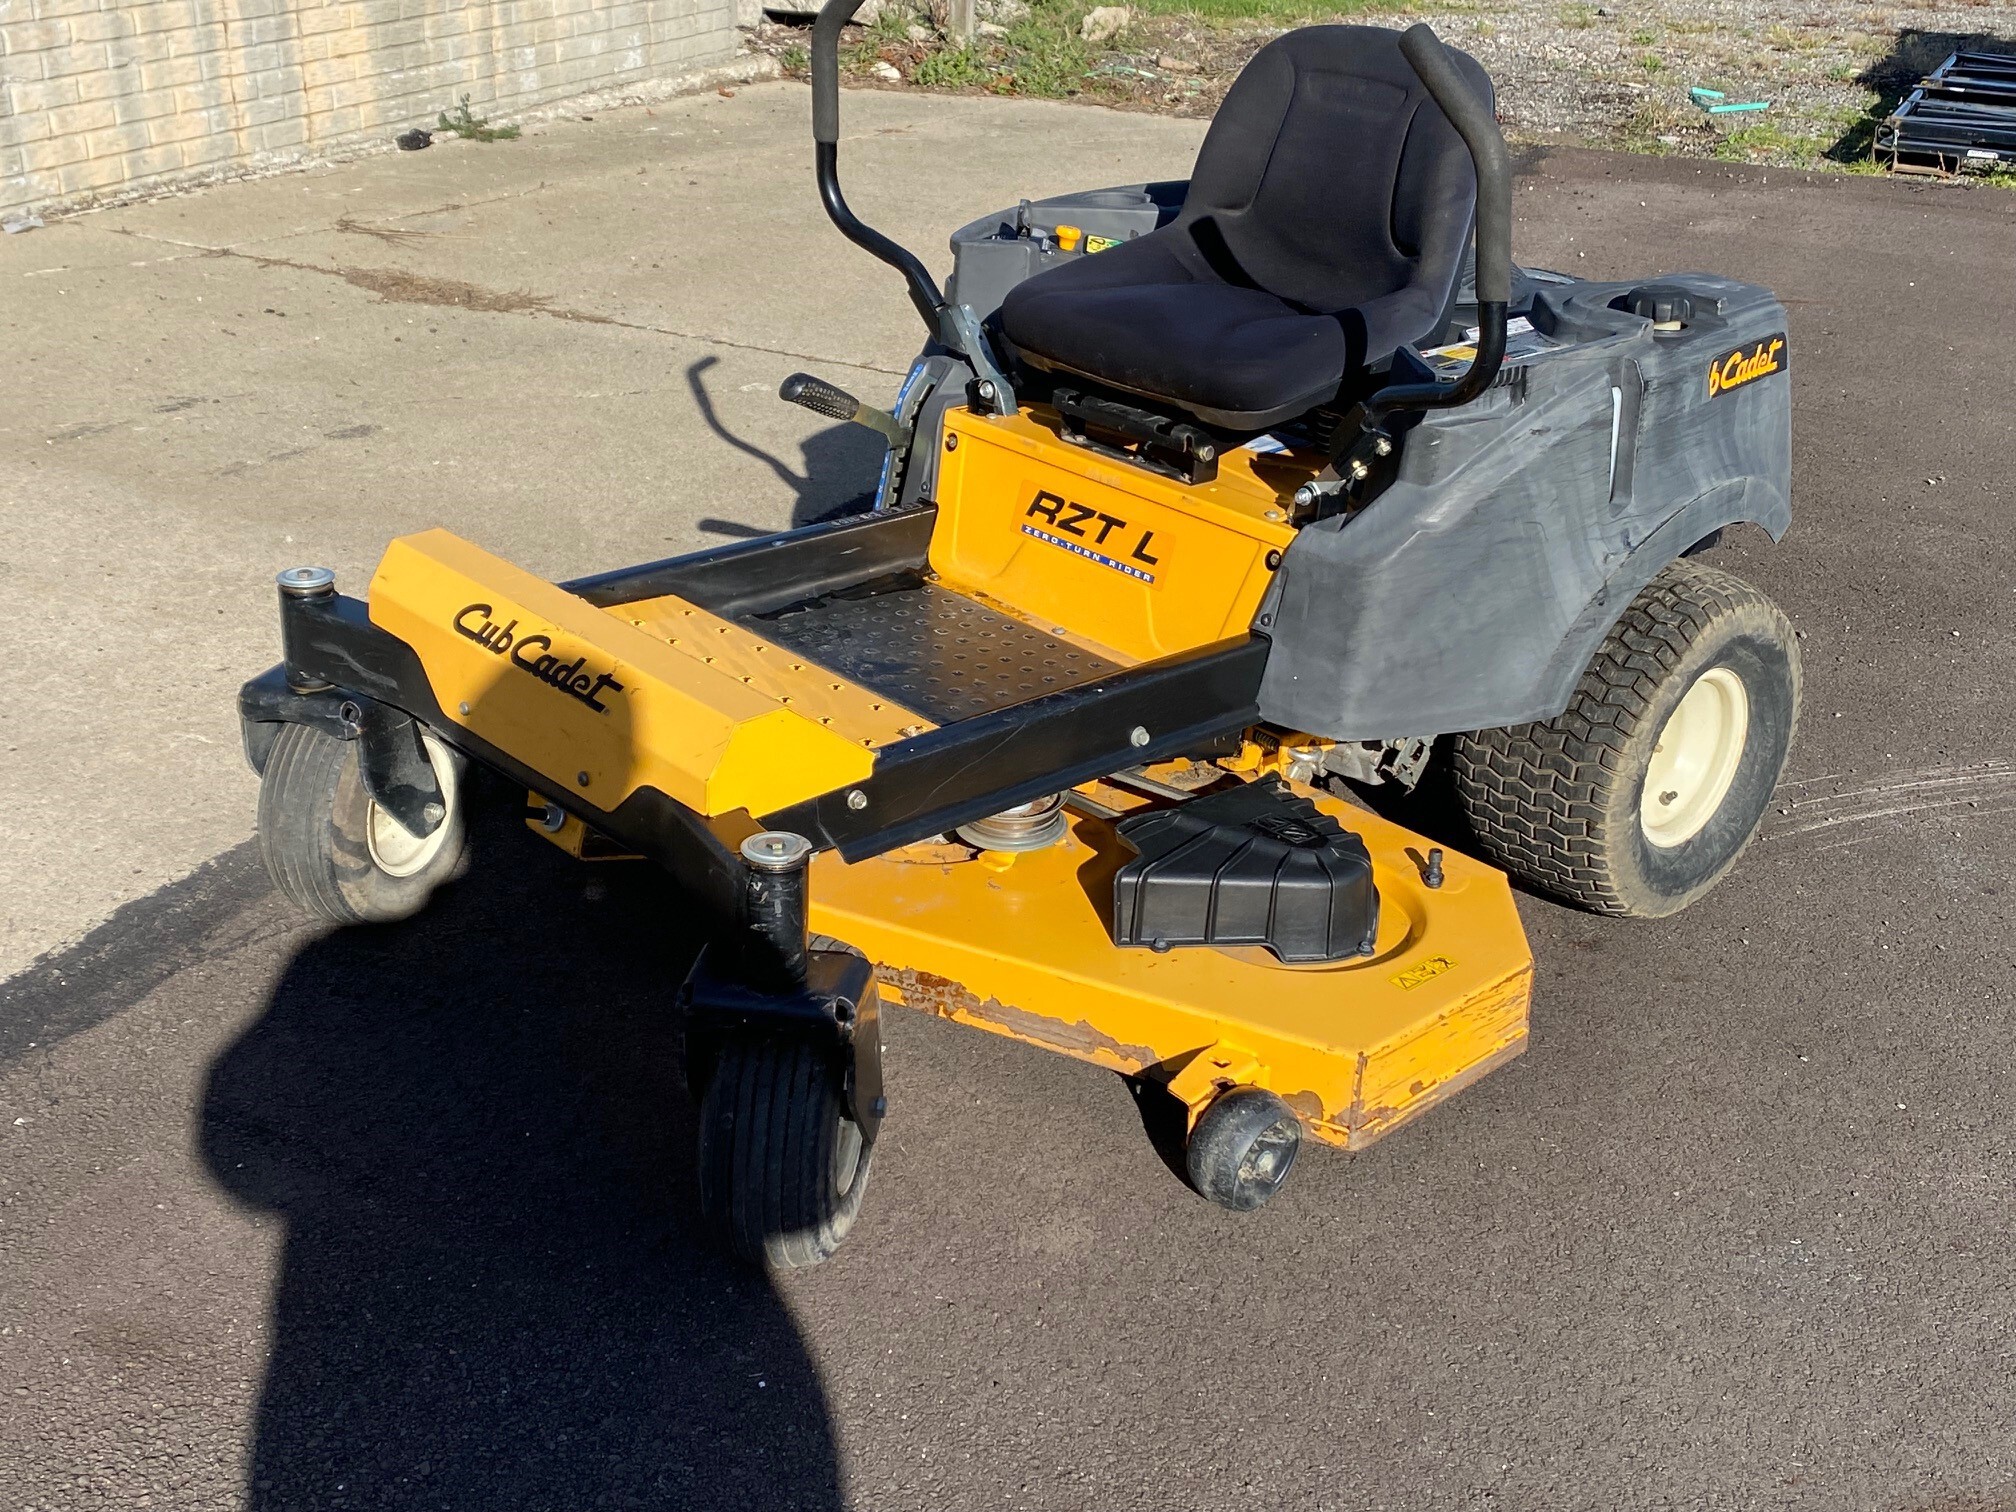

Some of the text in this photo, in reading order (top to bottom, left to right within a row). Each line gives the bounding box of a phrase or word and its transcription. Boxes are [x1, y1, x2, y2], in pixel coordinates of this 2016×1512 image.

[1720, 338, 1783, 389] Cadet
[1024, 525, 1151, 582] ZERO-TURN RIDER
[1025, 489, 1159, 566] RZT L
[453, 603, 624, 714] Cub Cadet
